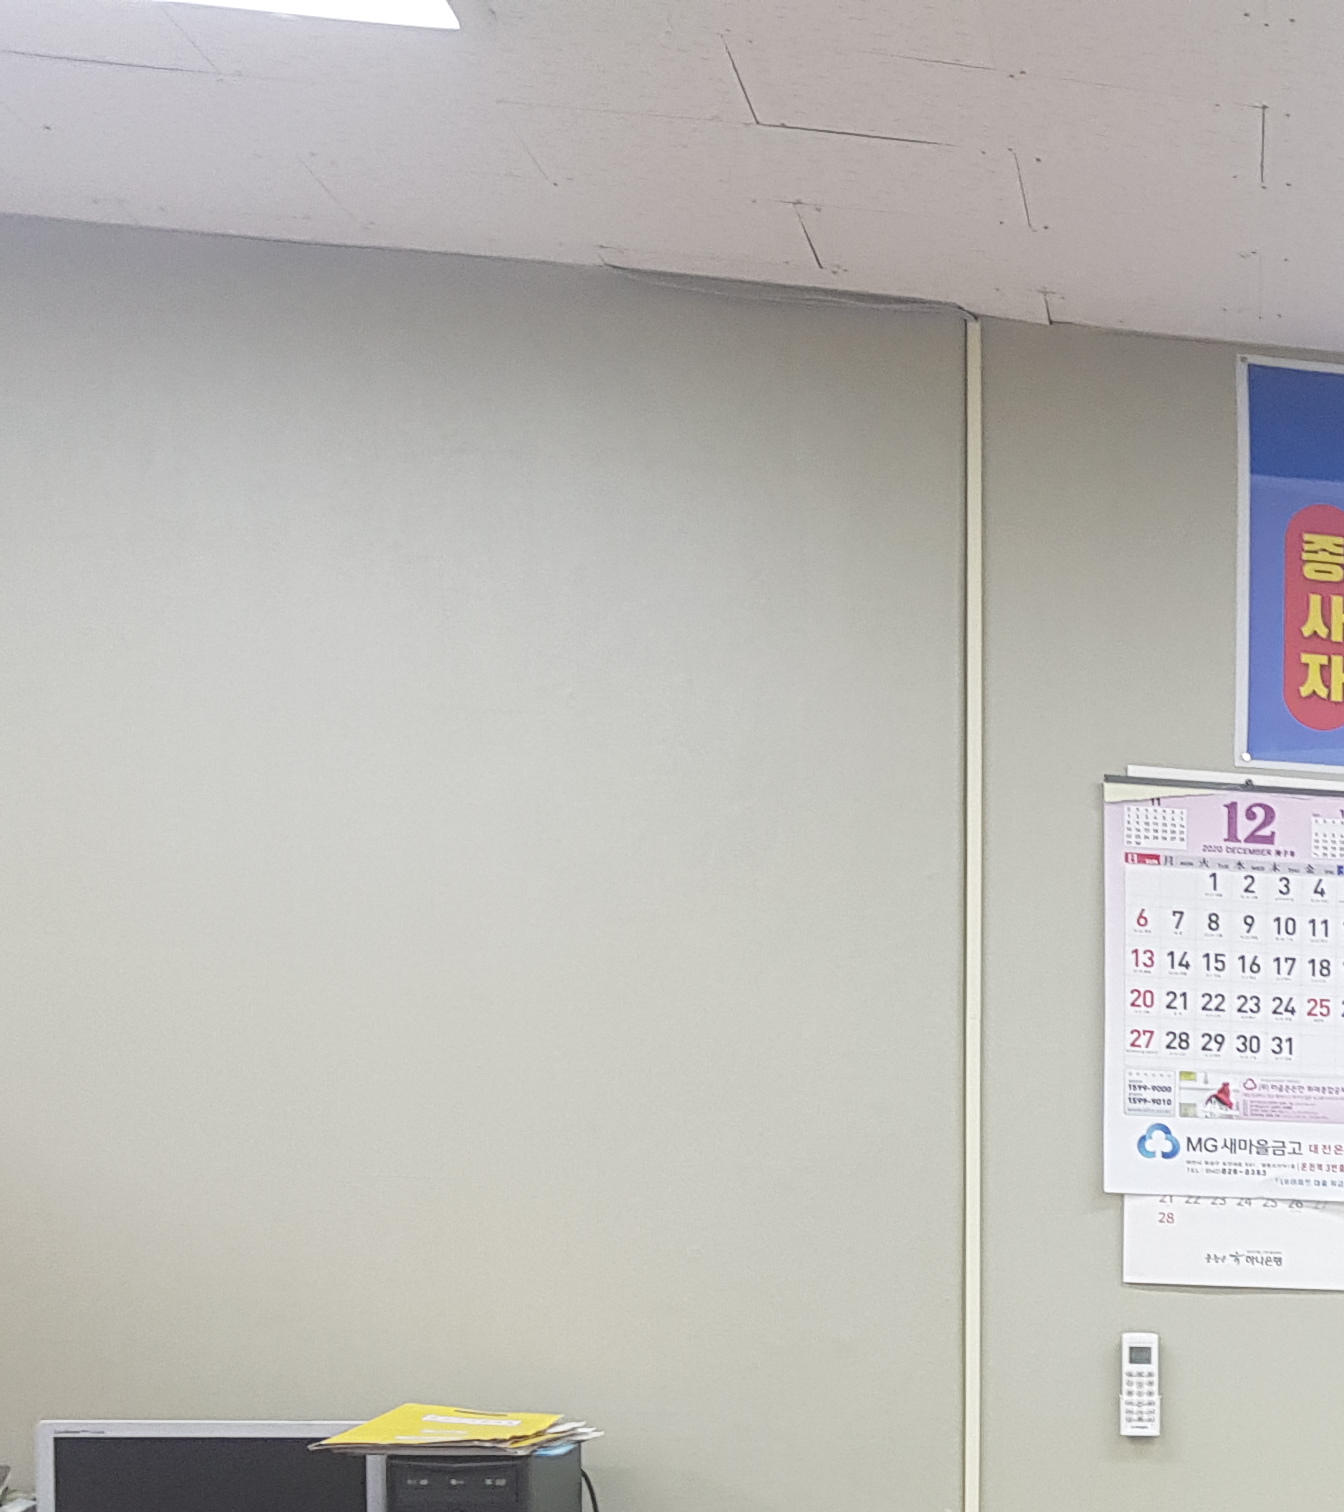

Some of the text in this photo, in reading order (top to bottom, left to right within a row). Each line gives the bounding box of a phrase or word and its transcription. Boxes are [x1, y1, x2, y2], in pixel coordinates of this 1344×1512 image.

[1223, 801, 1277, 846] 12
[1226, 845, 1272, 857] DECEMBER
[1210, 873, 1218, 891] 1
[1243, 875, 1256, 893] 2
[1278, 877, 1290, 895] 3
[1313, 879, 1325, 897] 4
[1136, 909, 1148, 927] 6
[1172, 911, 1184, 929] 7
[1207, 913, 1220, 931] 8
[1243, 915, 1255, 933] 9
[1273, 917, 1296, 935] 10
[1308, 919, 1329, 937] 11
[1131, 949, 1155, 968] 13
[1167, 951, 1190, 970] 14
[1202, 953, 1226, 972] 15
[1238, 955, 1261, 974] 16
[1273, 957, 1296, 976] 17
[1308, 959, 1331, 977] 18
[1130, 989, 1154, 1008] 20
[1166, 992, 1188, 1010] 21
[1201, 993, 1226, 1012] 22
[1237, 995, 1261, 1014] 23
[1272, 997, 1296, 1016] 24
[1307, 999, 1331, 1017] 25
[1129, 1029, 1293, 1055] 27 28 29 30 31
[1186, 1136, 1218, 1153] MG
[1221, 1137, 1304, 1157] 새마을금고
[1158, 1211, 1175, 1224] 28
